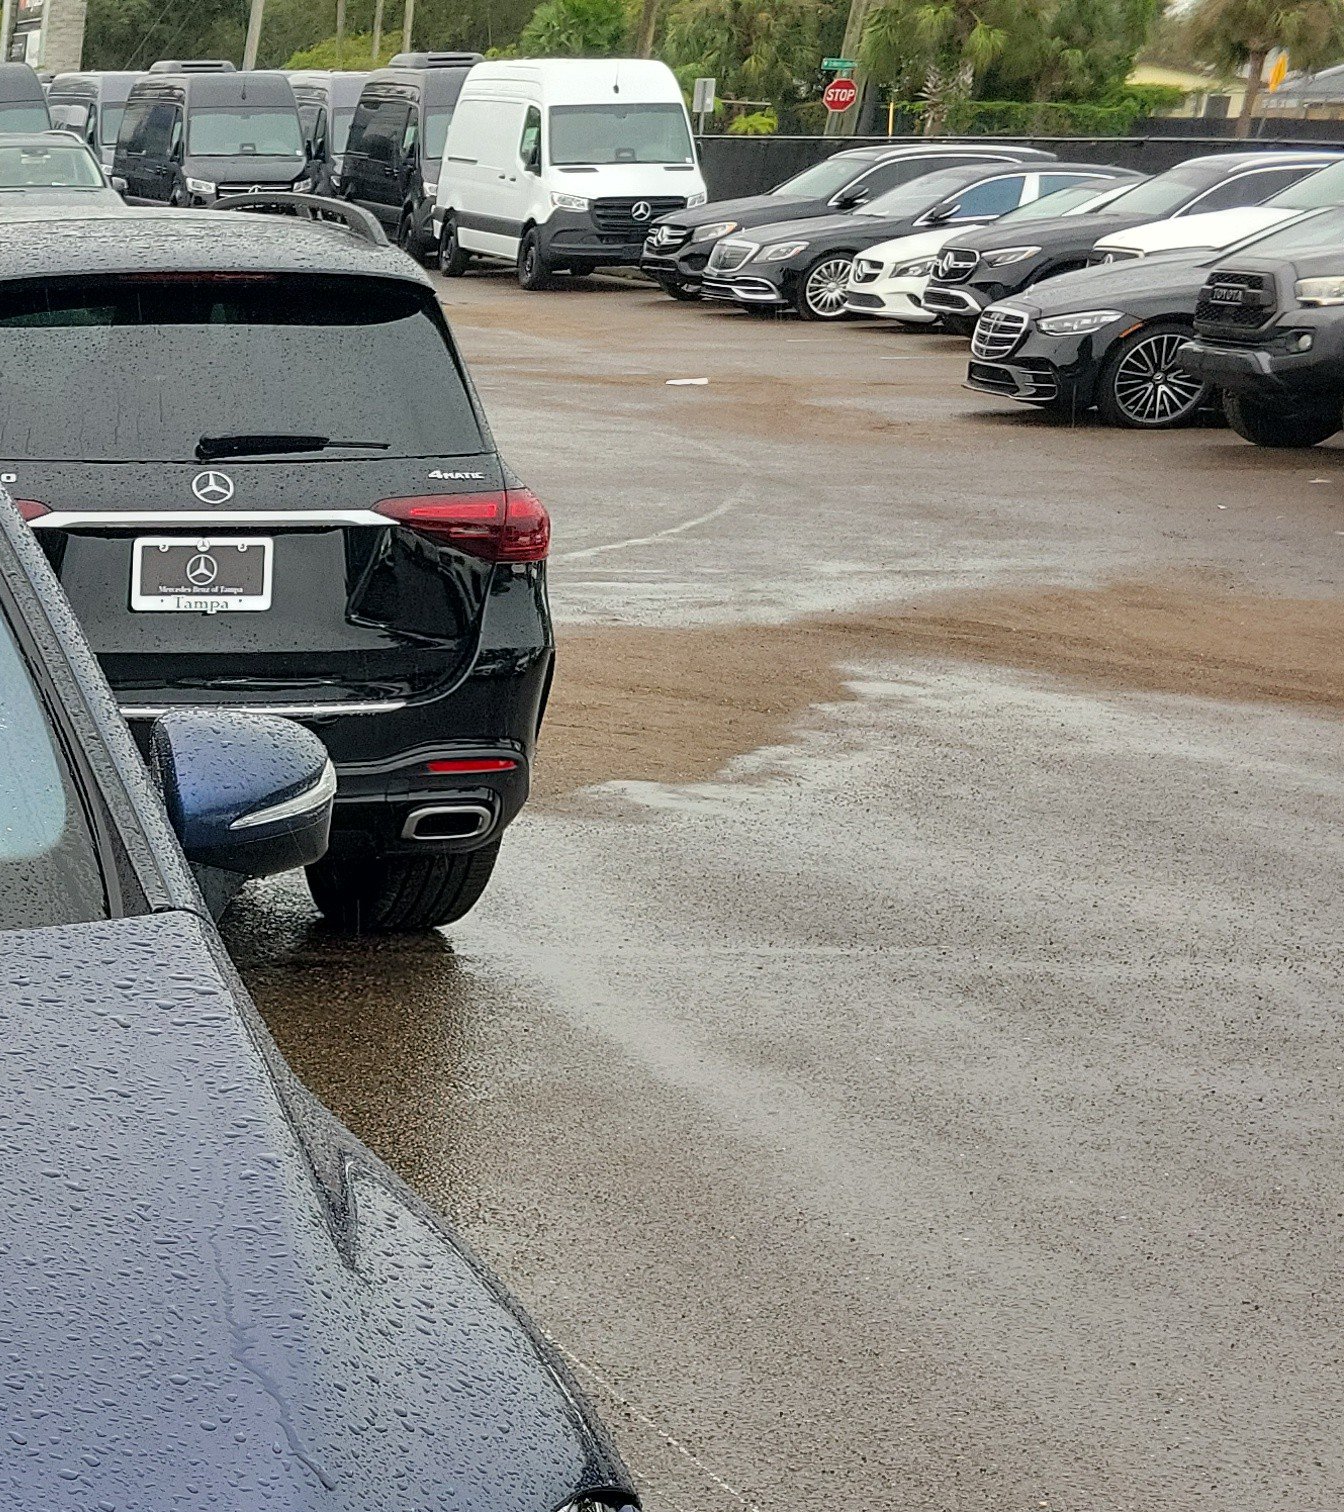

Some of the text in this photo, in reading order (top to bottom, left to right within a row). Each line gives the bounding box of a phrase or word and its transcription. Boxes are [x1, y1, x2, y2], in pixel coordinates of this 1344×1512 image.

[826, 88, 856, 102] STOP
[1213, 288, 1243, 301] TOYOTA
[428, 470, 485, 480] 4MATIC
[220, 585, 244, 595] Tampa
[176, 596, 229, 612] Tampa
